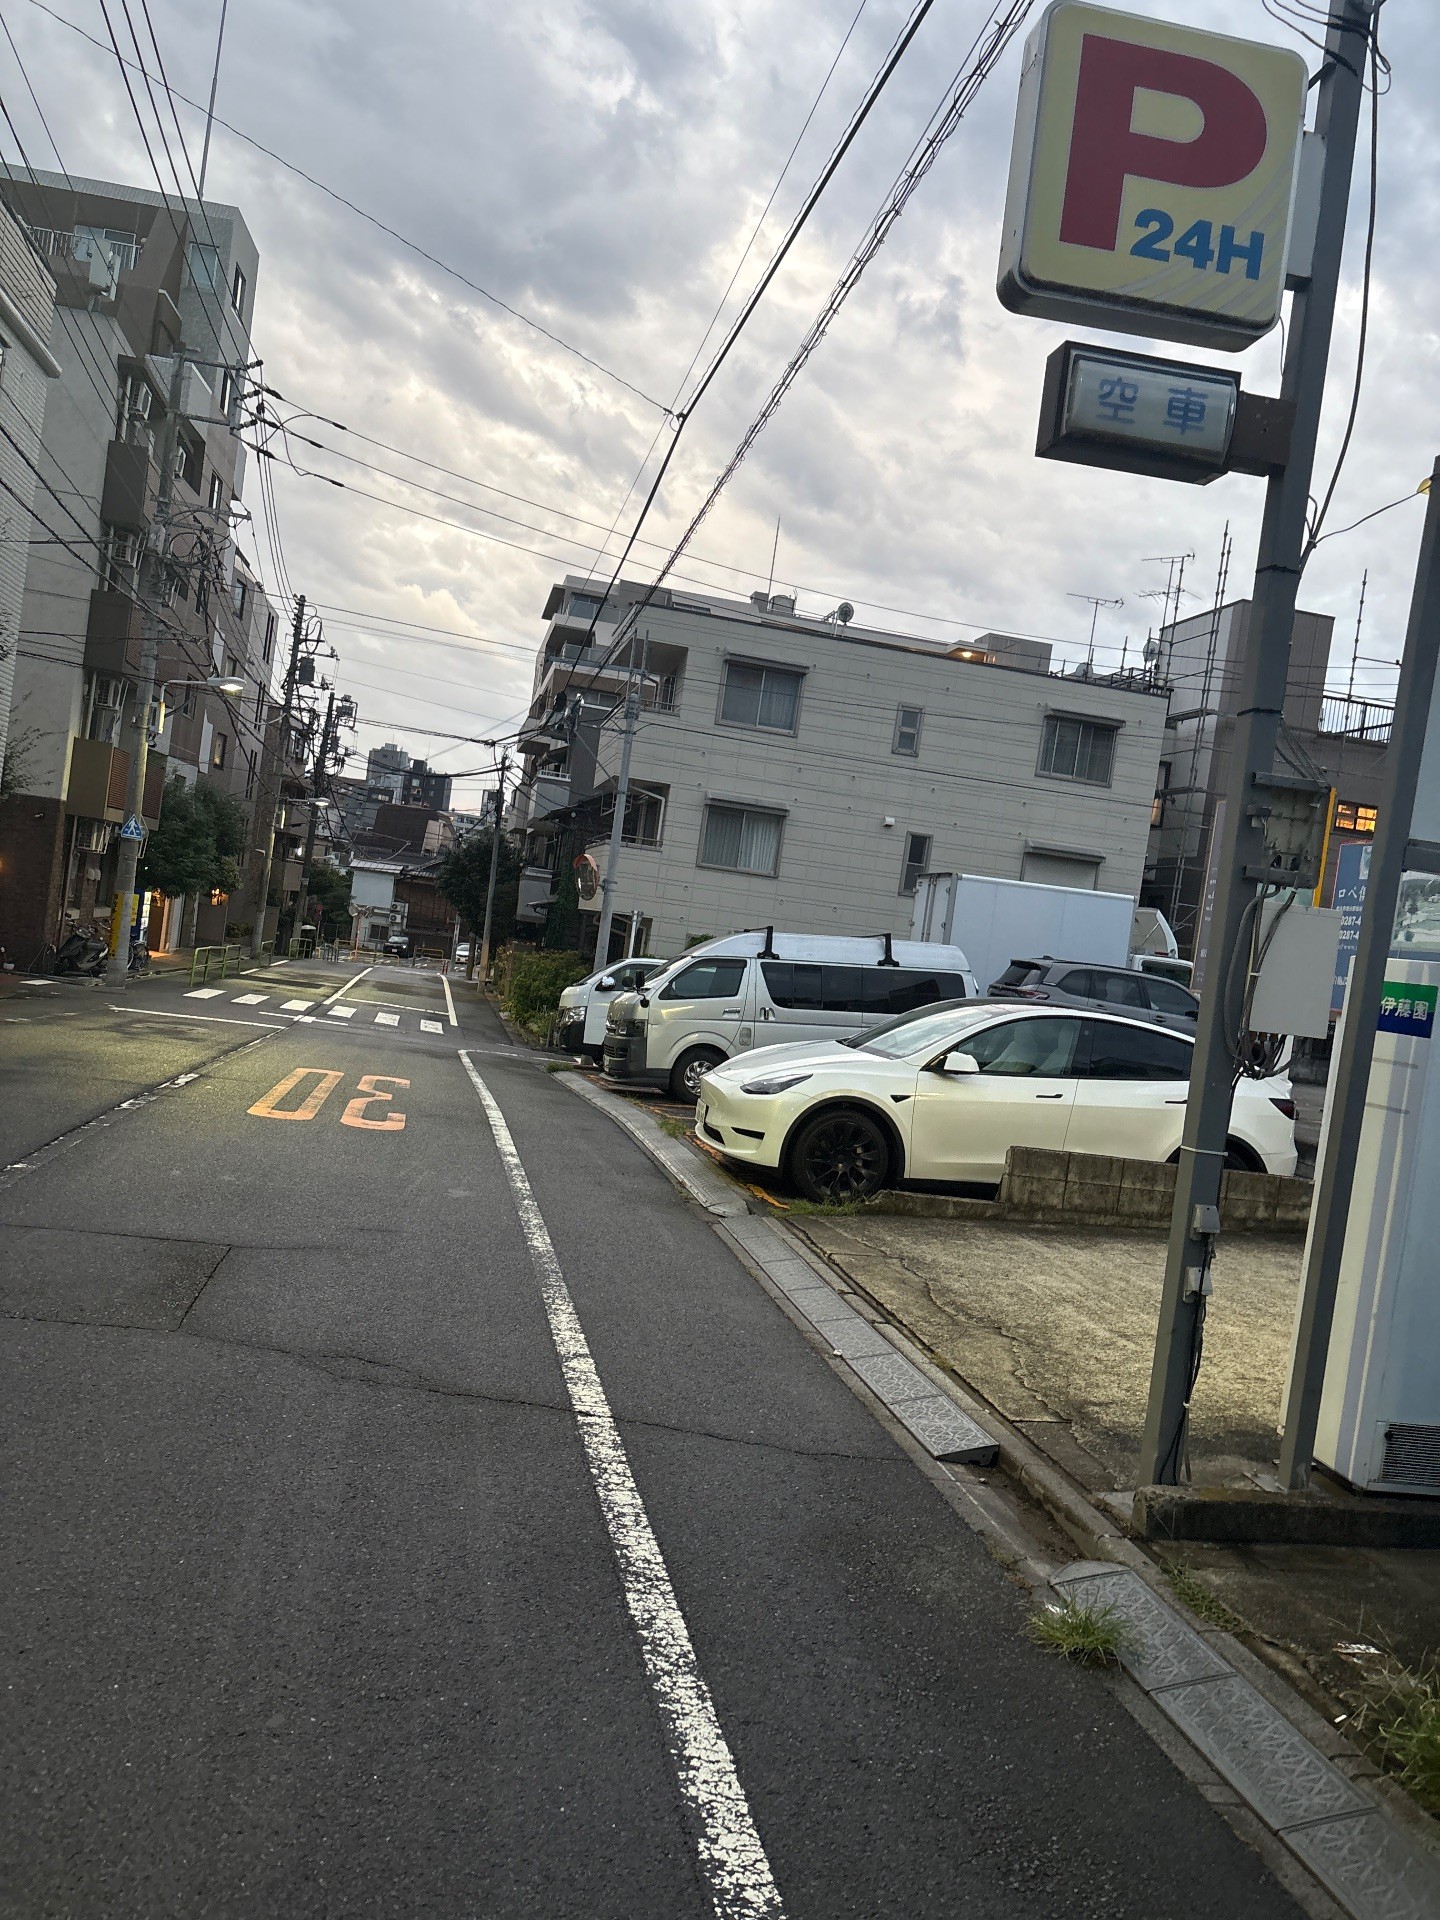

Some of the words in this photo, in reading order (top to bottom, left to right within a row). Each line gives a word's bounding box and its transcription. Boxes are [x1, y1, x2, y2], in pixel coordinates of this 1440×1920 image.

[1059, 33, 1267, 252] P
[1130, 207, 1265, 281] 24H
[1096, 375, 1207, 435] 空車
[1380, 995, 1429, 1021] 伊藤園
[247, 1067, 411, 1131] 30
